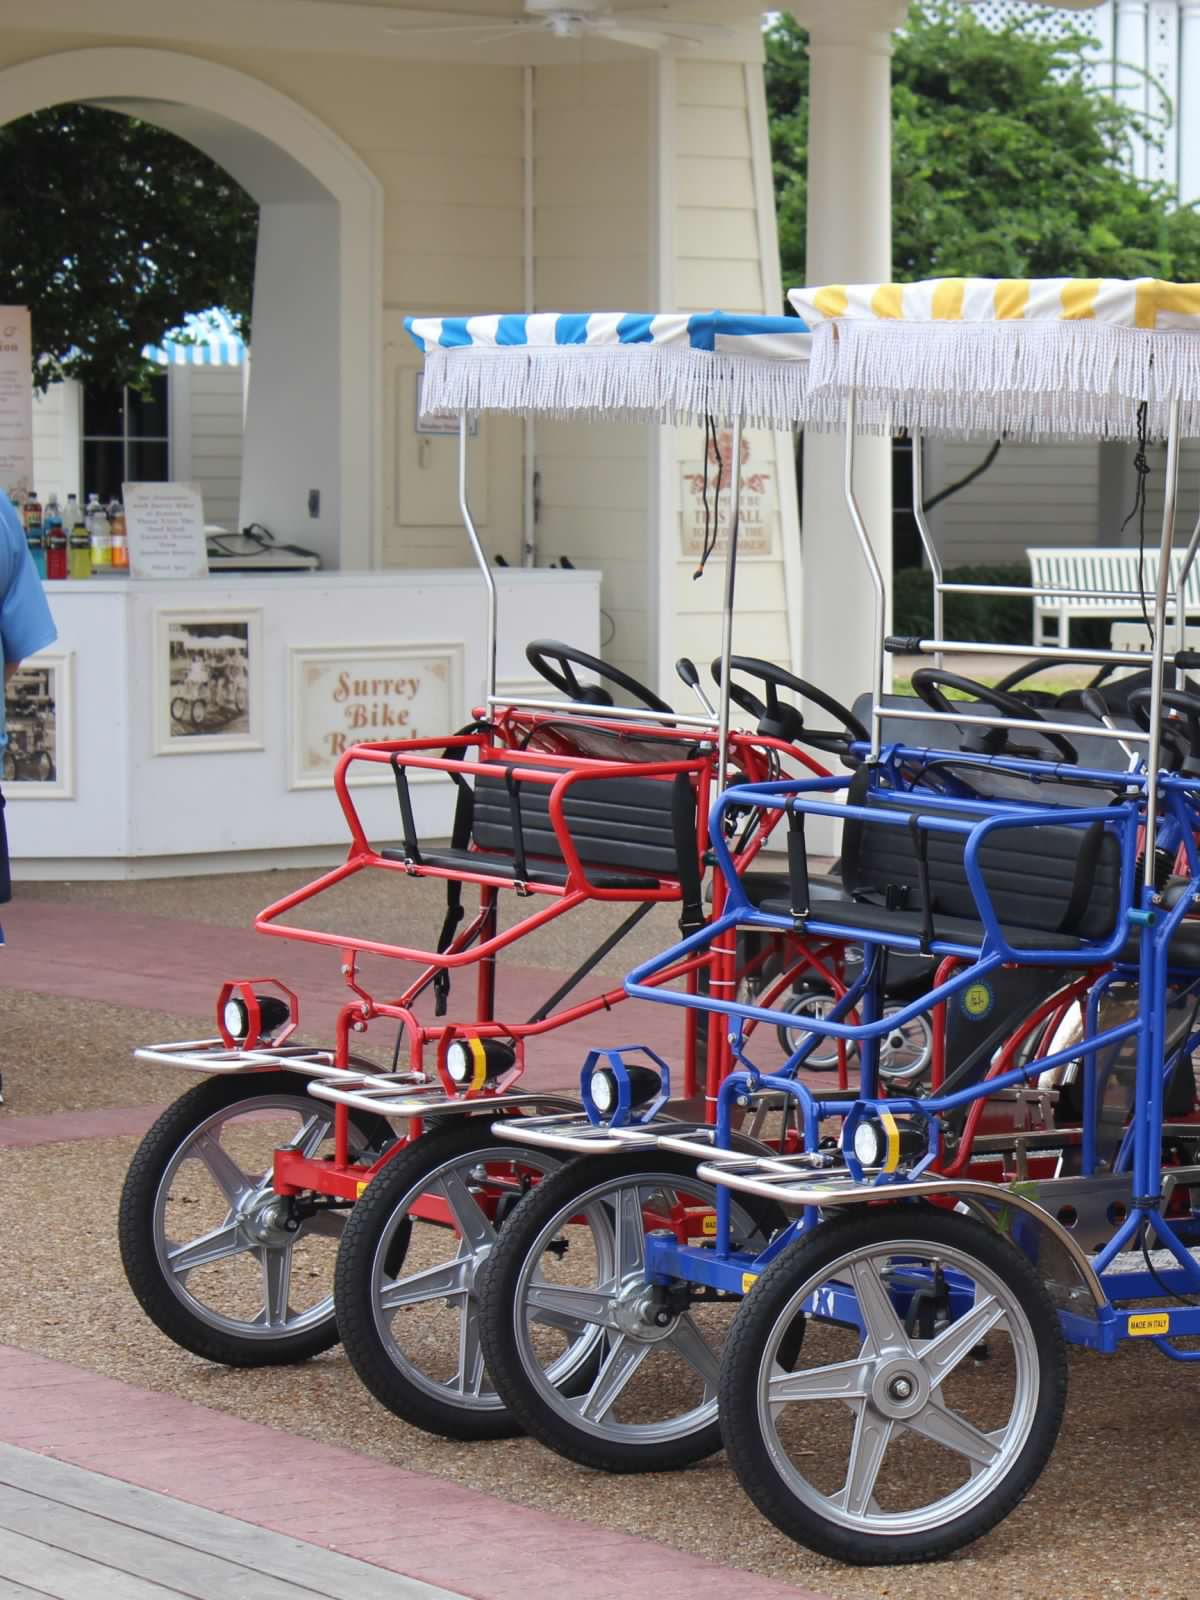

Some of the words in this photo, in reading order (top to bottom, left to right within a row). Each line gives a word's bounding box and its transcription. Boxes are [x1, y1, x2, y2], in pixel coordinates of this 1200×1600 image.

[333, 671, 420, 702] Surrey
[344, 703, 410, 729] Bike
[1130, 1320, 1146, 1329] MADE
[1153, 1319, 1168, 1328] ITALY
